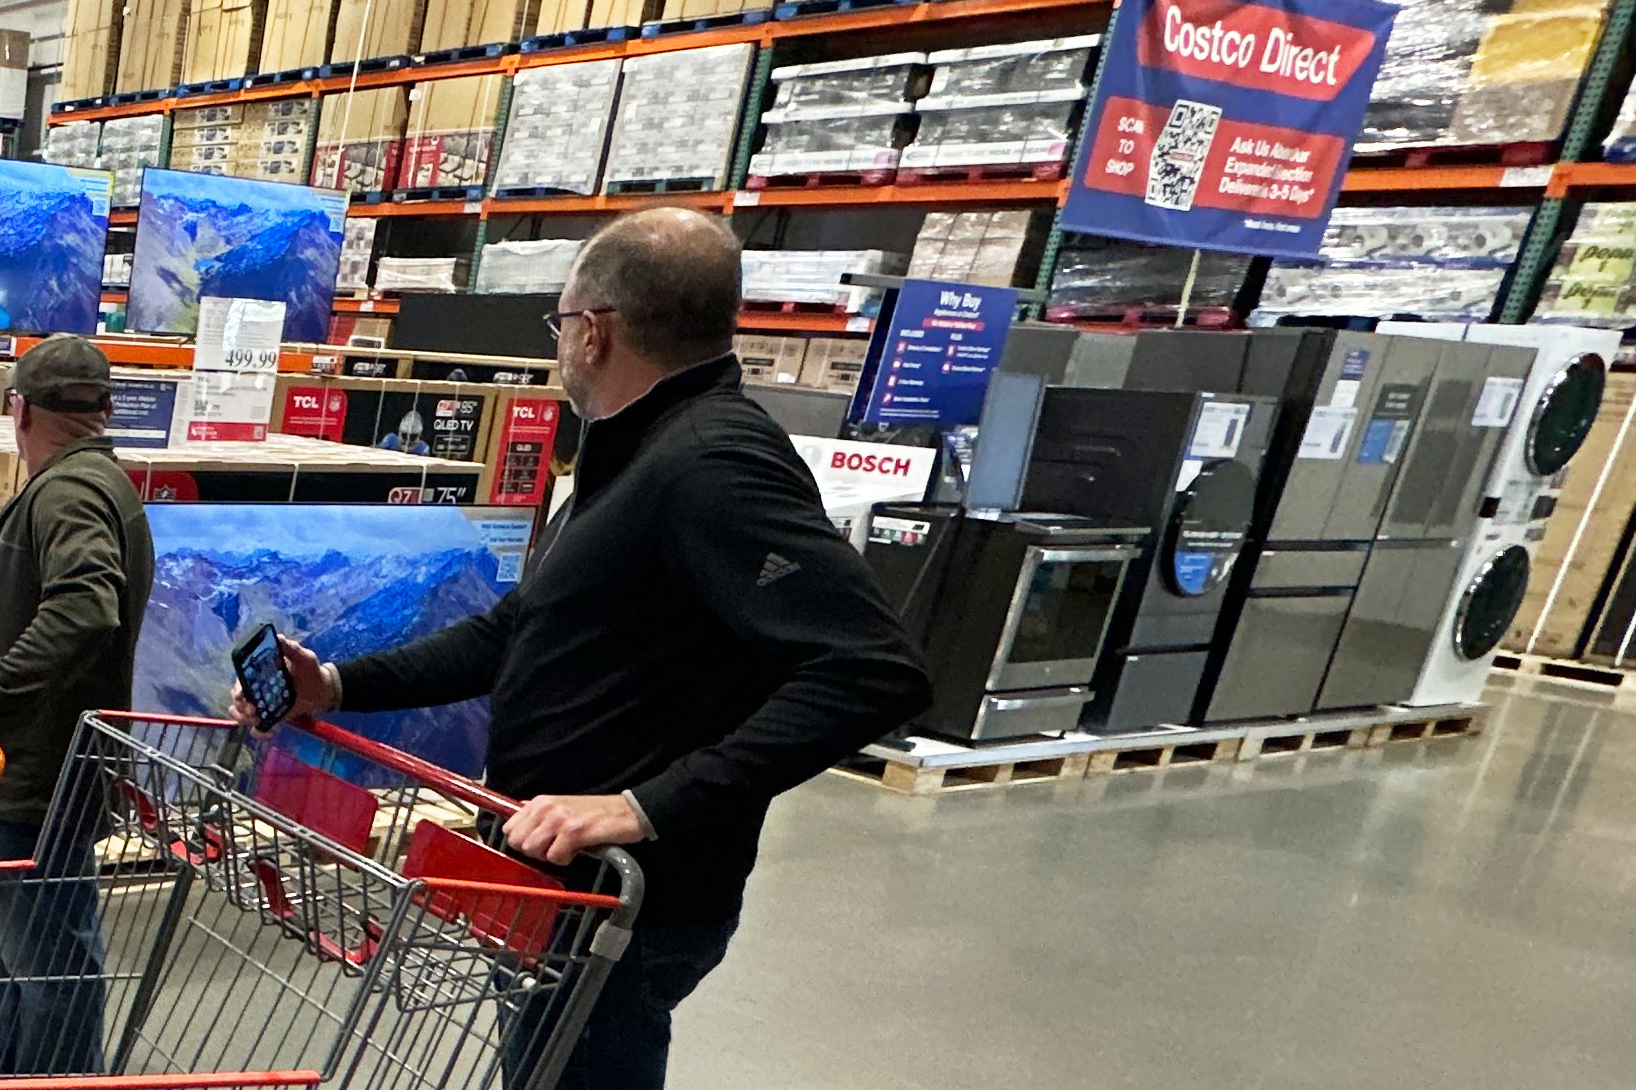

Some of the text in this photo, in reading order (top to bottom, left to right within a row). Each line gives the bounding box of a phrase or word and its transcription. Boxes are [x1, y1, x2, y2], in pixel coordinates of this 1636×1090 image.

[1164, 5, 1341, 85] Costco Direct
[1118, 139, 1135, 155] TO
[1229, 137, 1255, 155] Ask
[1255, 140, 1270, 157] Us
[1105, 158, 1135, 178] SHOP
[1269, 184, 1290, 200] 3-5
[939, 291, 983, 311] Why Buy
[225, 349, 277, 370] 499.99
[293, 395, 319, 409] TCL
[512, 406, 535, 418] TCL
[433, 418, 475, 431] QLED TV
[830, 451, 911, 476] BOSCH
[437, 487, 467, 504] 75"
